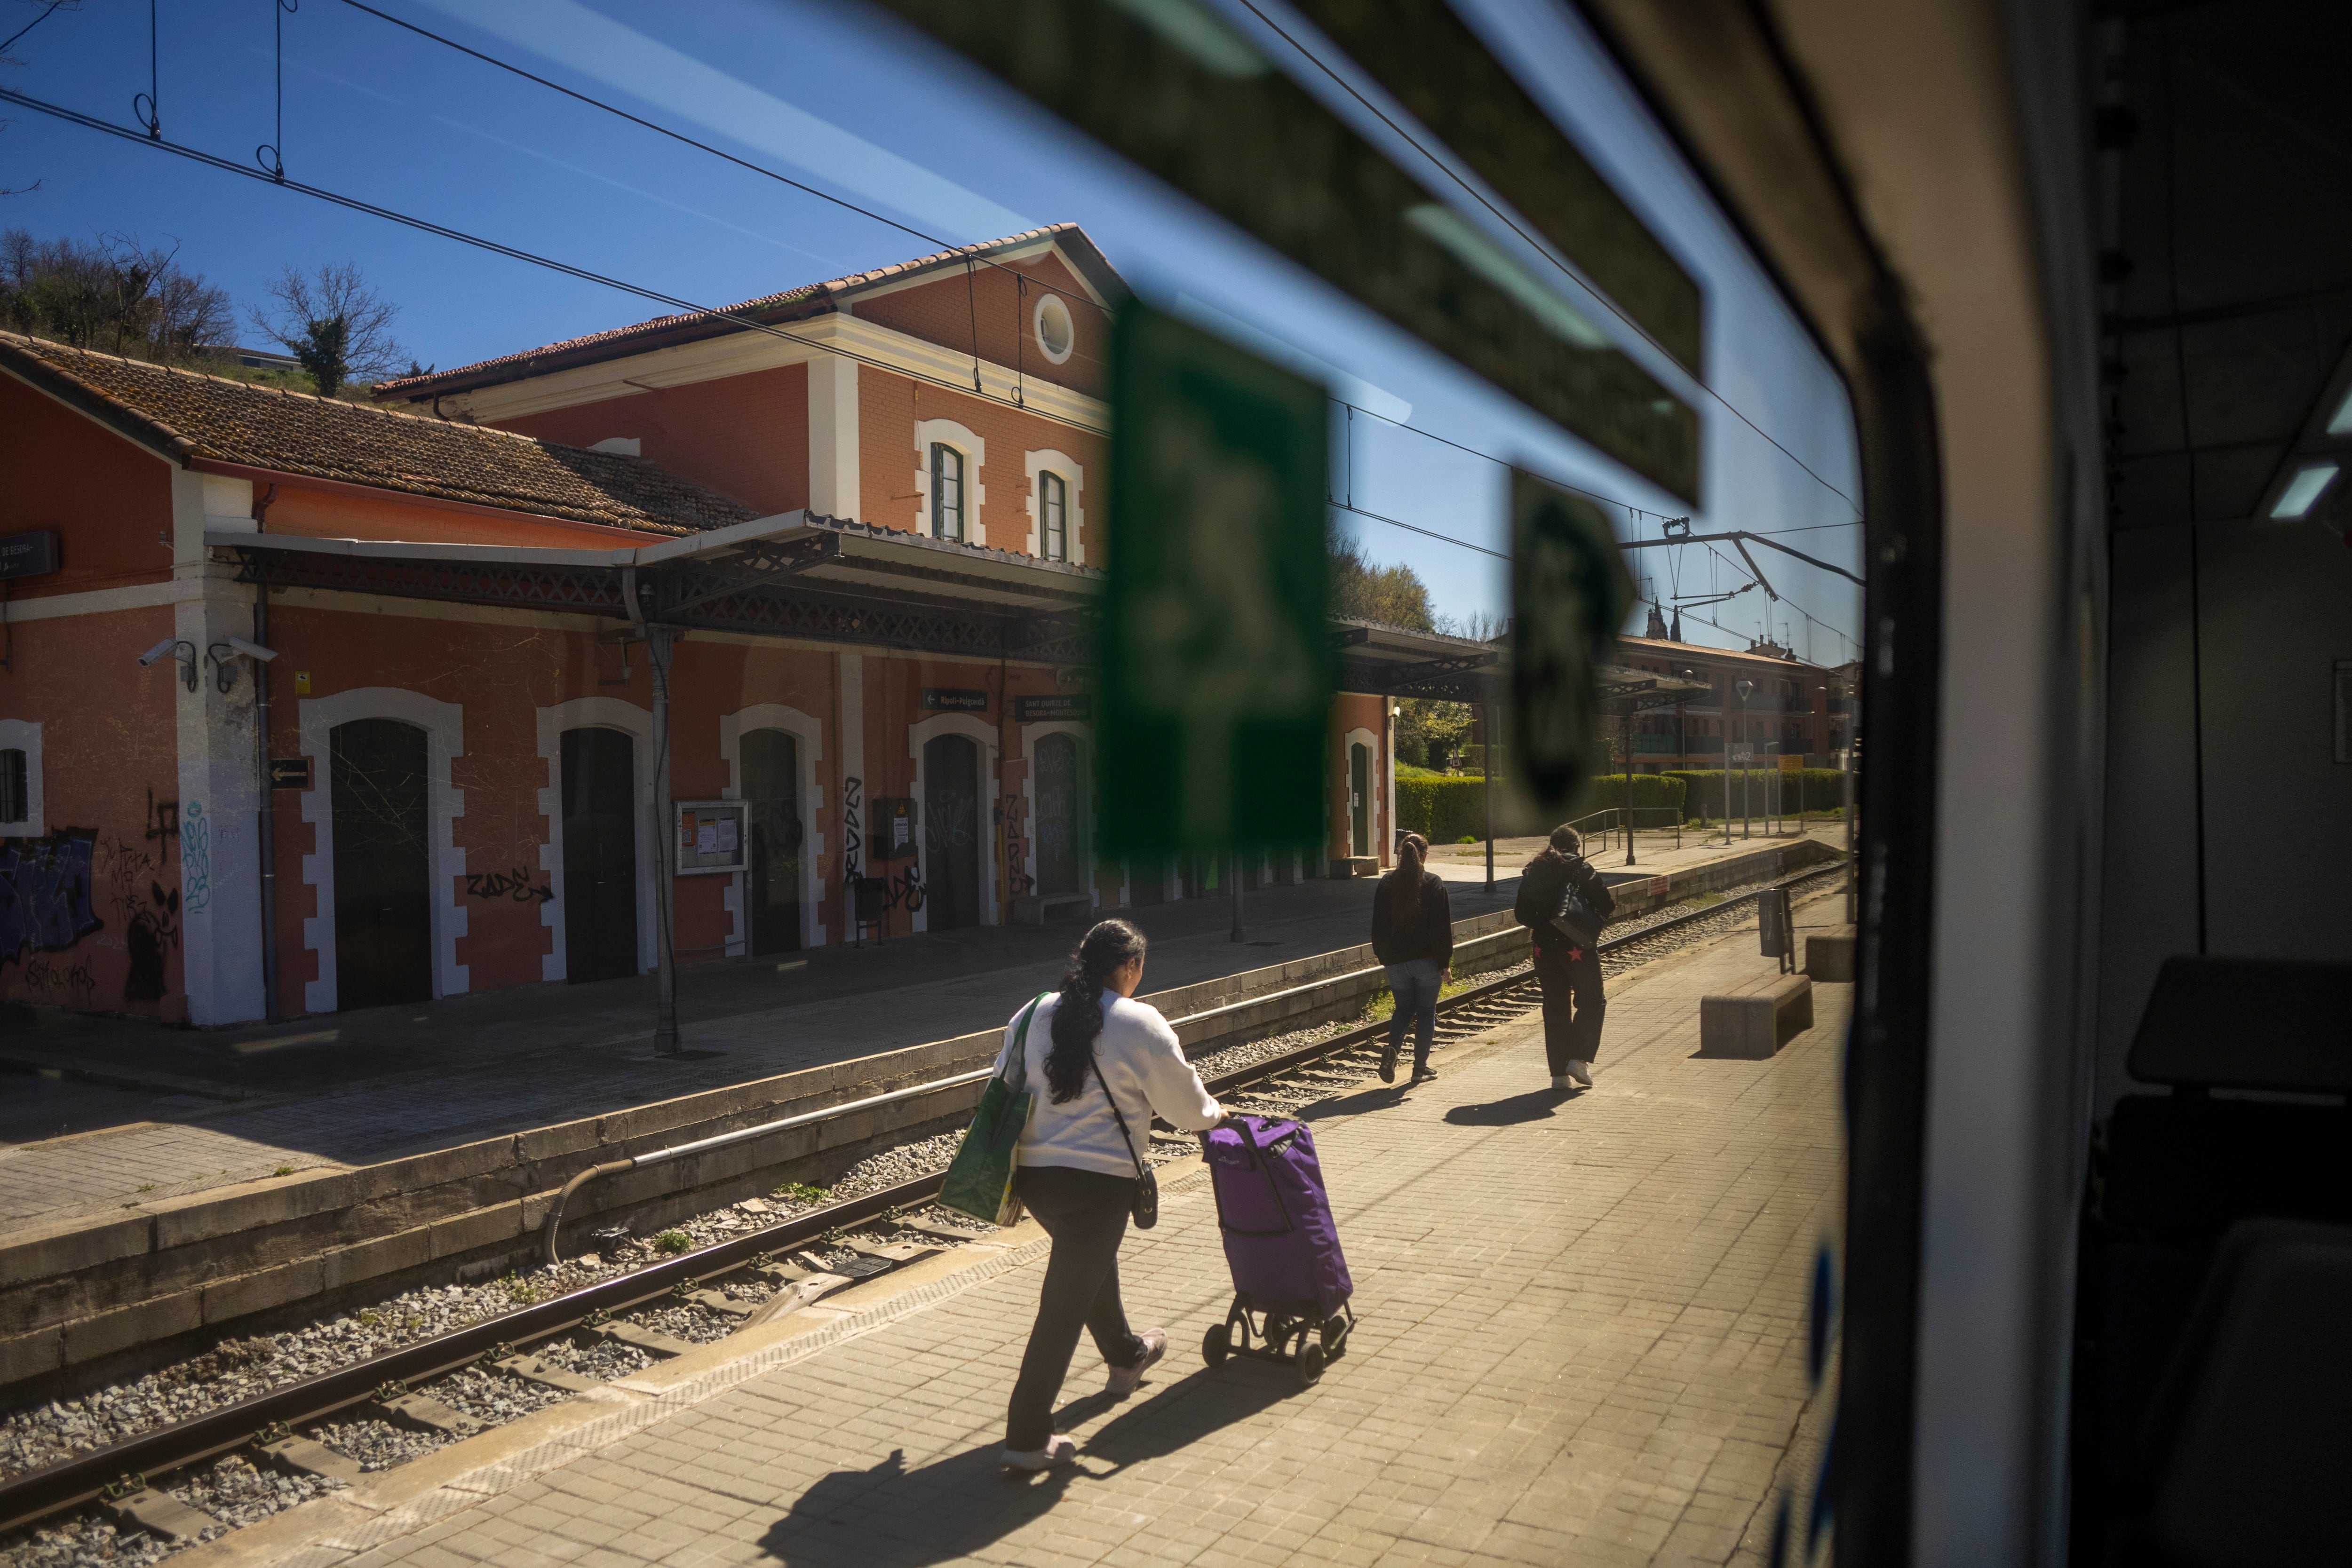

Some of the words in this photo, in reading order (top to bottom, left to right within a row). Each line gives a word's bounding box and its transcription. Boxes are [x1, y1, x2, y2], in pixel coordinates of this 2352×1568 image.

[2, 546, 9, 556] DE
[941, 696, 985, 707] Ripoll-Puigcerdà
[1041, 700, 1062, 709] QUIRZE
